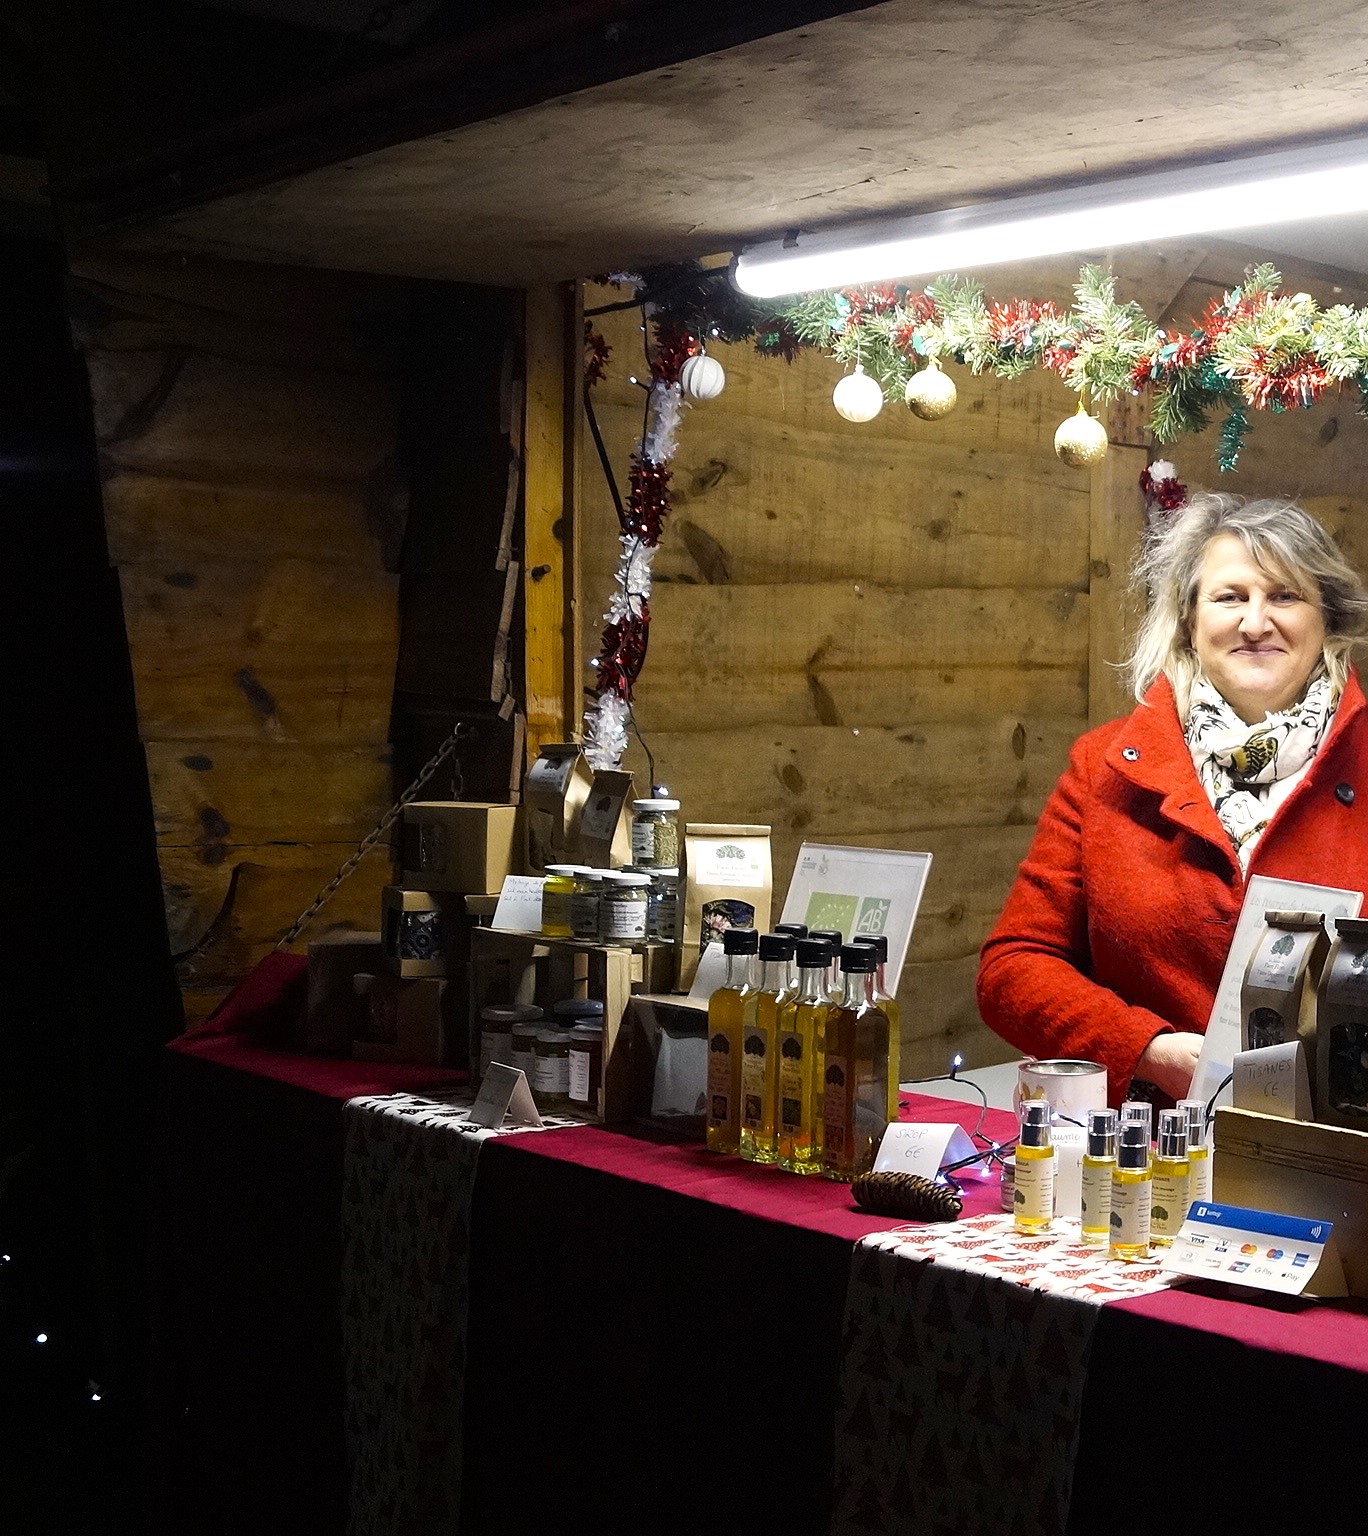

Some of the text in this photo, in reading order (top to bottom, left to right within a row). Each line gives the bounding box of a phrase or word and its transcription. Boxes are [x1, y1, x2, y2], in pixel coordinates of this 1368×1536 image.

[1243, 1058, 1293, 1079] TISANES
[896, 1129, 929, 1139] SIROP
[1050, 1132, 1081, 1141] aume
[1191, 1236, 1206, 1245] VISA
